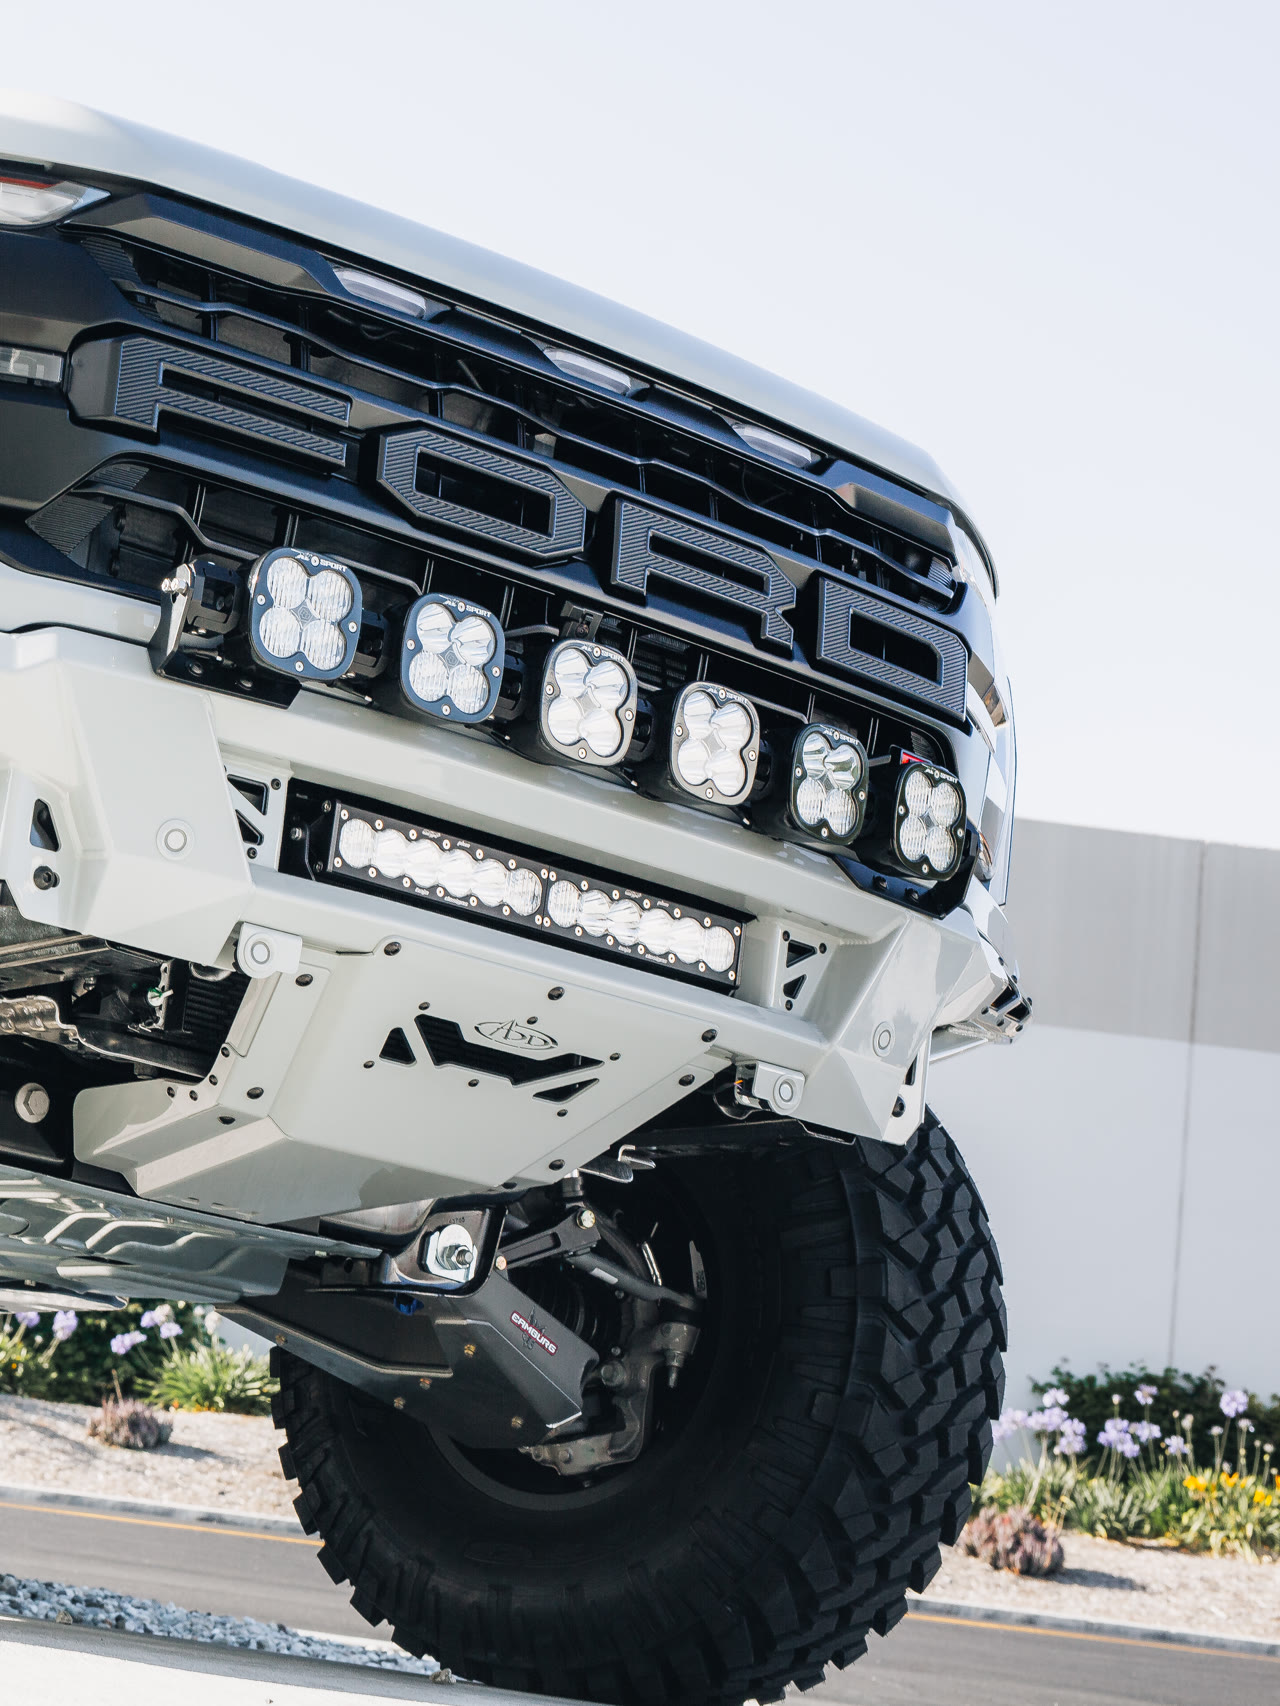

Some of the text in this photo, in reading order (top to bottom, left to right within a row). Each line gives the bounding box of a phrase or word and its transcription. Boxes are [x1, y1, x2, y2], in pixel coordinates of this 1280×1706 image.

[112, 334, 970, 723] FORD
[319, 558, 349, 573] SPORT
[465, 604, 493, 618] SPORT
[511, 1311, 558, 1355] CAMBURG
